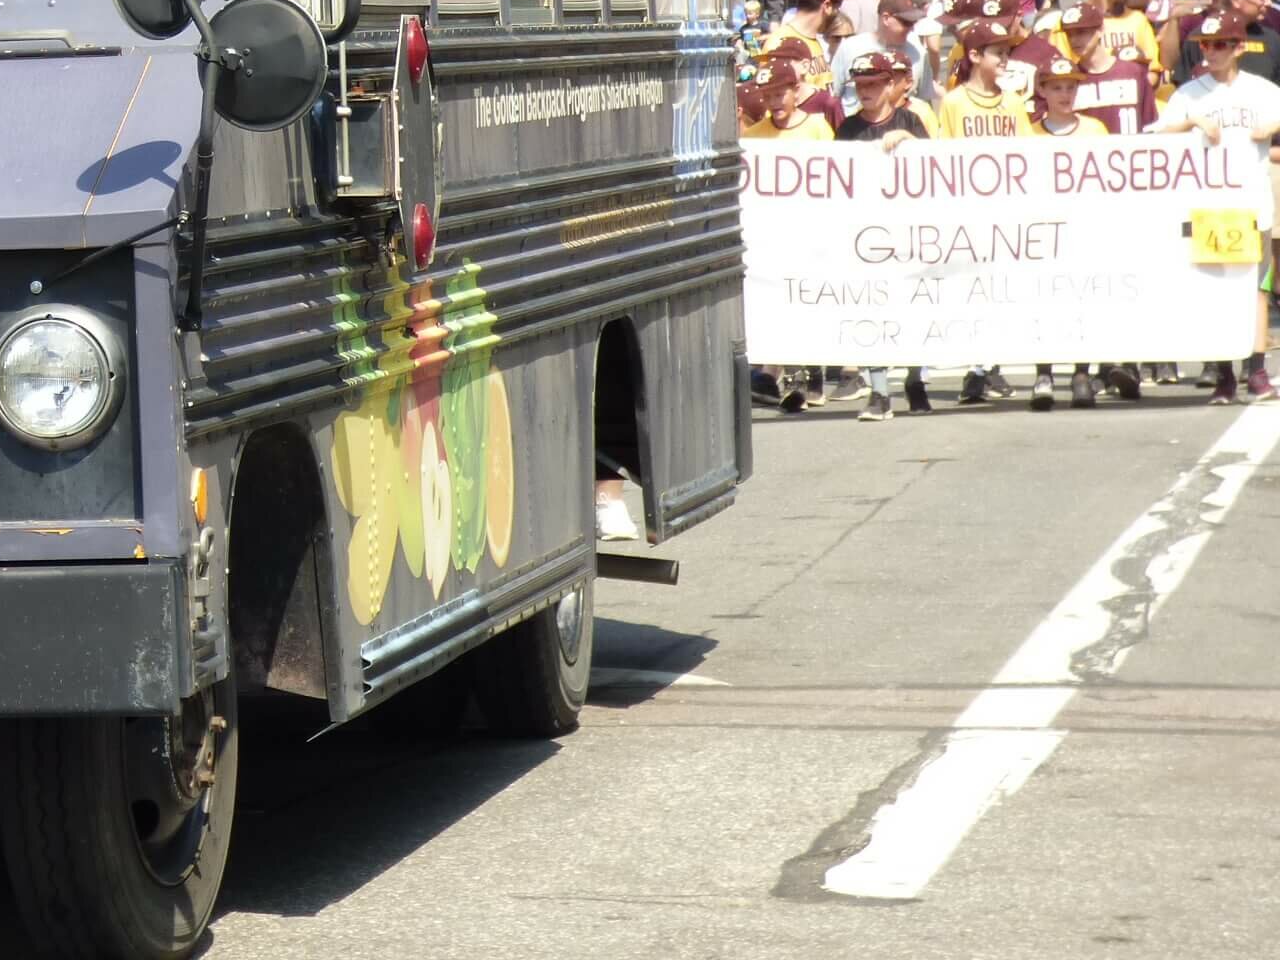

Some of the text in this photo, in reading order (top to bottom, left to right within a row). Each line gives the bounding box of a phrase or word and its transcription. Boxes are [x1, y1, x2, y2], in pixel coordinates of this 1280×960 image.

[474, 86, 492, 128] The
[493, 82, 525, 126] Golden
[526, 78, 566, 127] Backpack
[962, 113, 1017, 137] GOLDEN
[740, 146, 1242, 200] LDEN JUNIOR BASEBALL
[1205, 229, 1243, 253] 42
[783, 277, 889, 306] TEAMS
[910, 276, 945, 305] AT
[966, 275, 1017, 304] ALL
[838, 319, 902, 347] FOR
